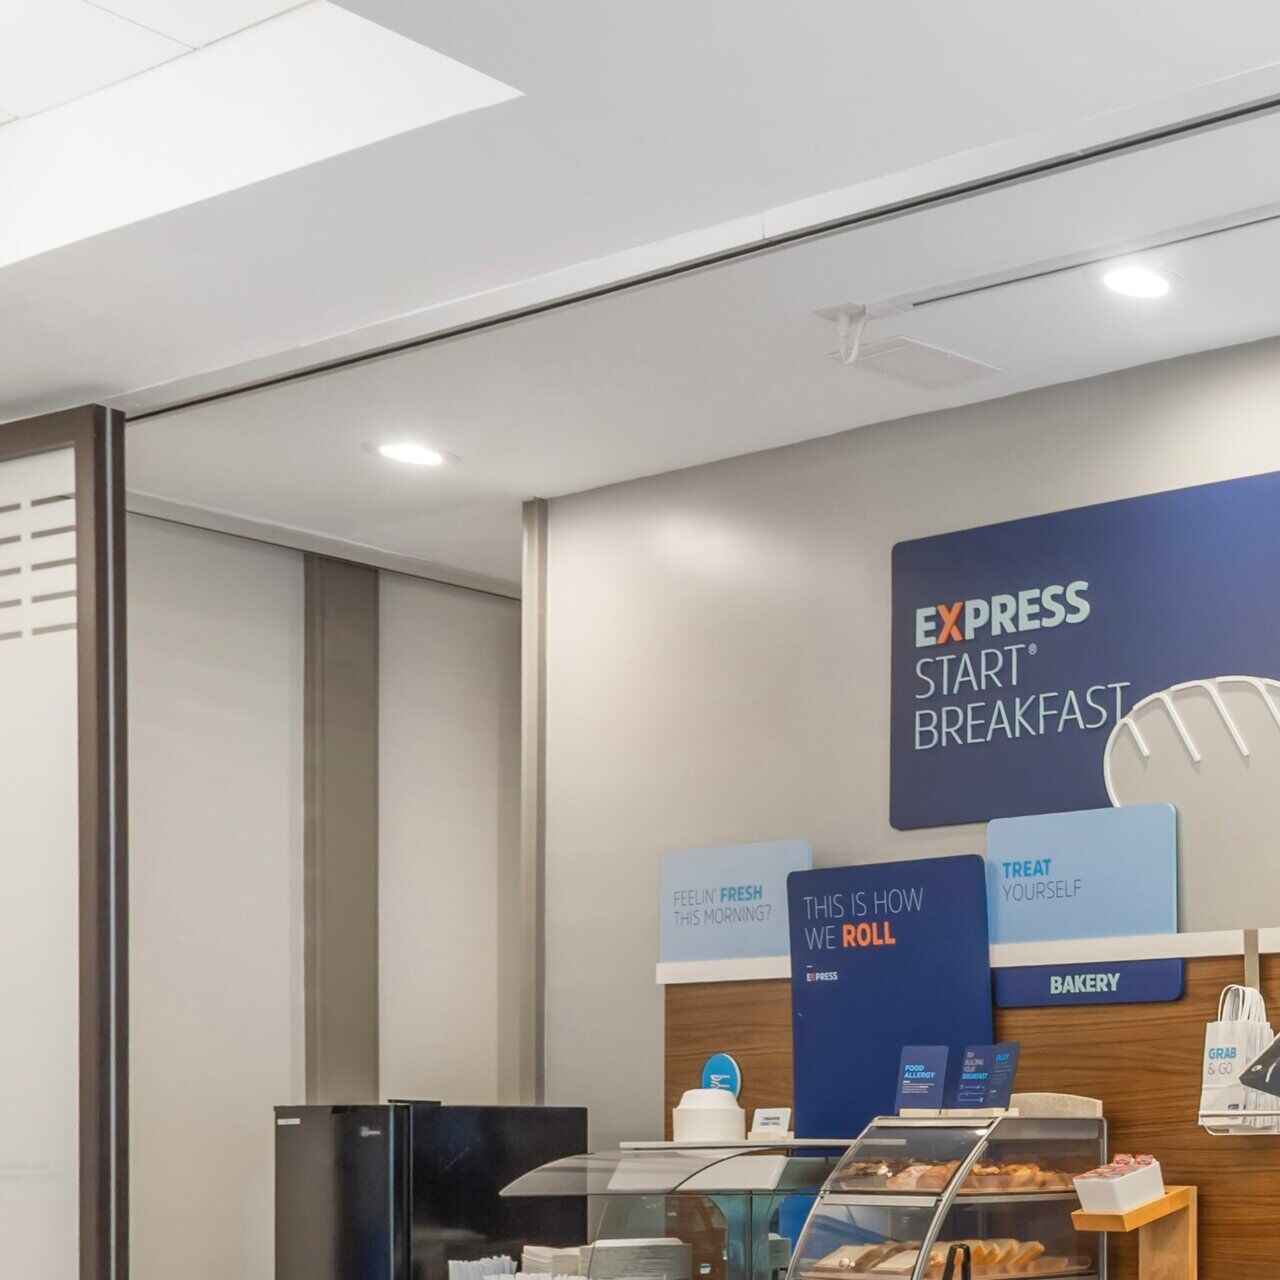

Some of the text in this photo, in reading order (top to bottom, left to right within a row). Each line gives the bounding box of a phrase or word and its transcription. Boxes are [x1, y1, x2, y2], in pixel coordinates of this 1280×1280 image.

[915, 580, 1091, 648] EXPRESS
[914, 681, 1131, 750] BREAKFAST
[1002, 859, 1052, 879] TREAT
[720, 884, 764, 902] FRESH
[1002, 878, 1083, 902] YOURSELF
[803, 887, 924, 920] THIS IS HOW
[673, 904, 772, 927] THIS MORNING?
[805, 921, 897, 950] WE ROLL
[806, 971, 838, 982] EXPRESS
[1050, 972, 1121, 994] BAKERY
[1208, 1047, 1237, 1060] GRAB
[903, 1071, 936, 1079] ALLERGY
[905, 1064, 925, 1072] FOOD
[1207, 1062, 1233, 1075] & GO
